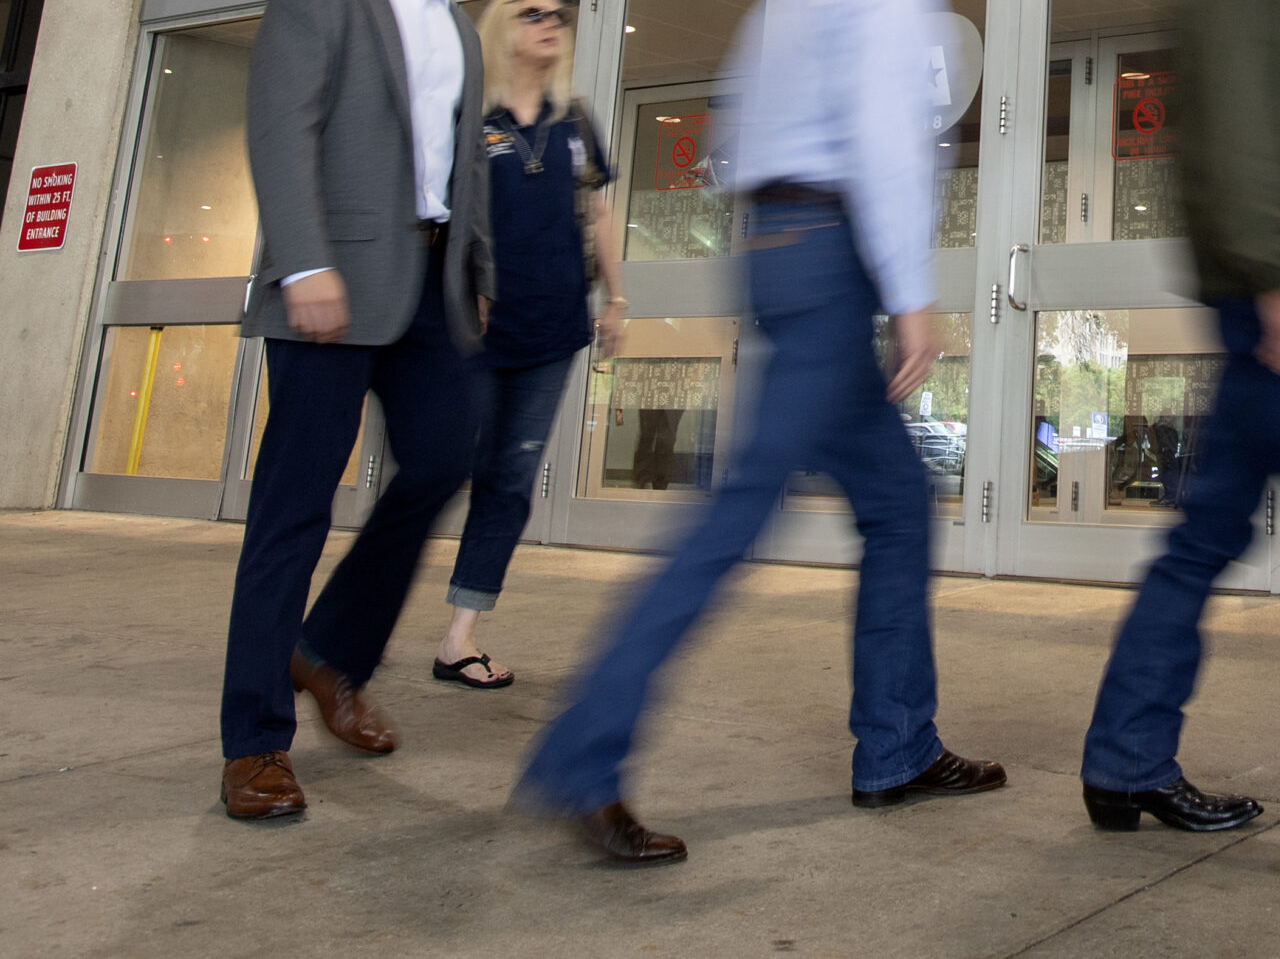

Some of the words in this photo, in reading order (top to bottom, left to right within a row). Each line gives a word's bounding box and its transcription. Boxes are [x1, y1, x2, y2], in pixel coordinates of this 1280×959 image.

[31, 177, 42, 189] NO
[43, 173, 73, 188] SMOKING
[28, 193, 51, 206] WITHIN
[52, 192, 61, 204] 25
[26, 211, 36, 223] OF
[36, 208, 67, 223] BUILDING
[26, 226, 60, 240] ENTRANCE
